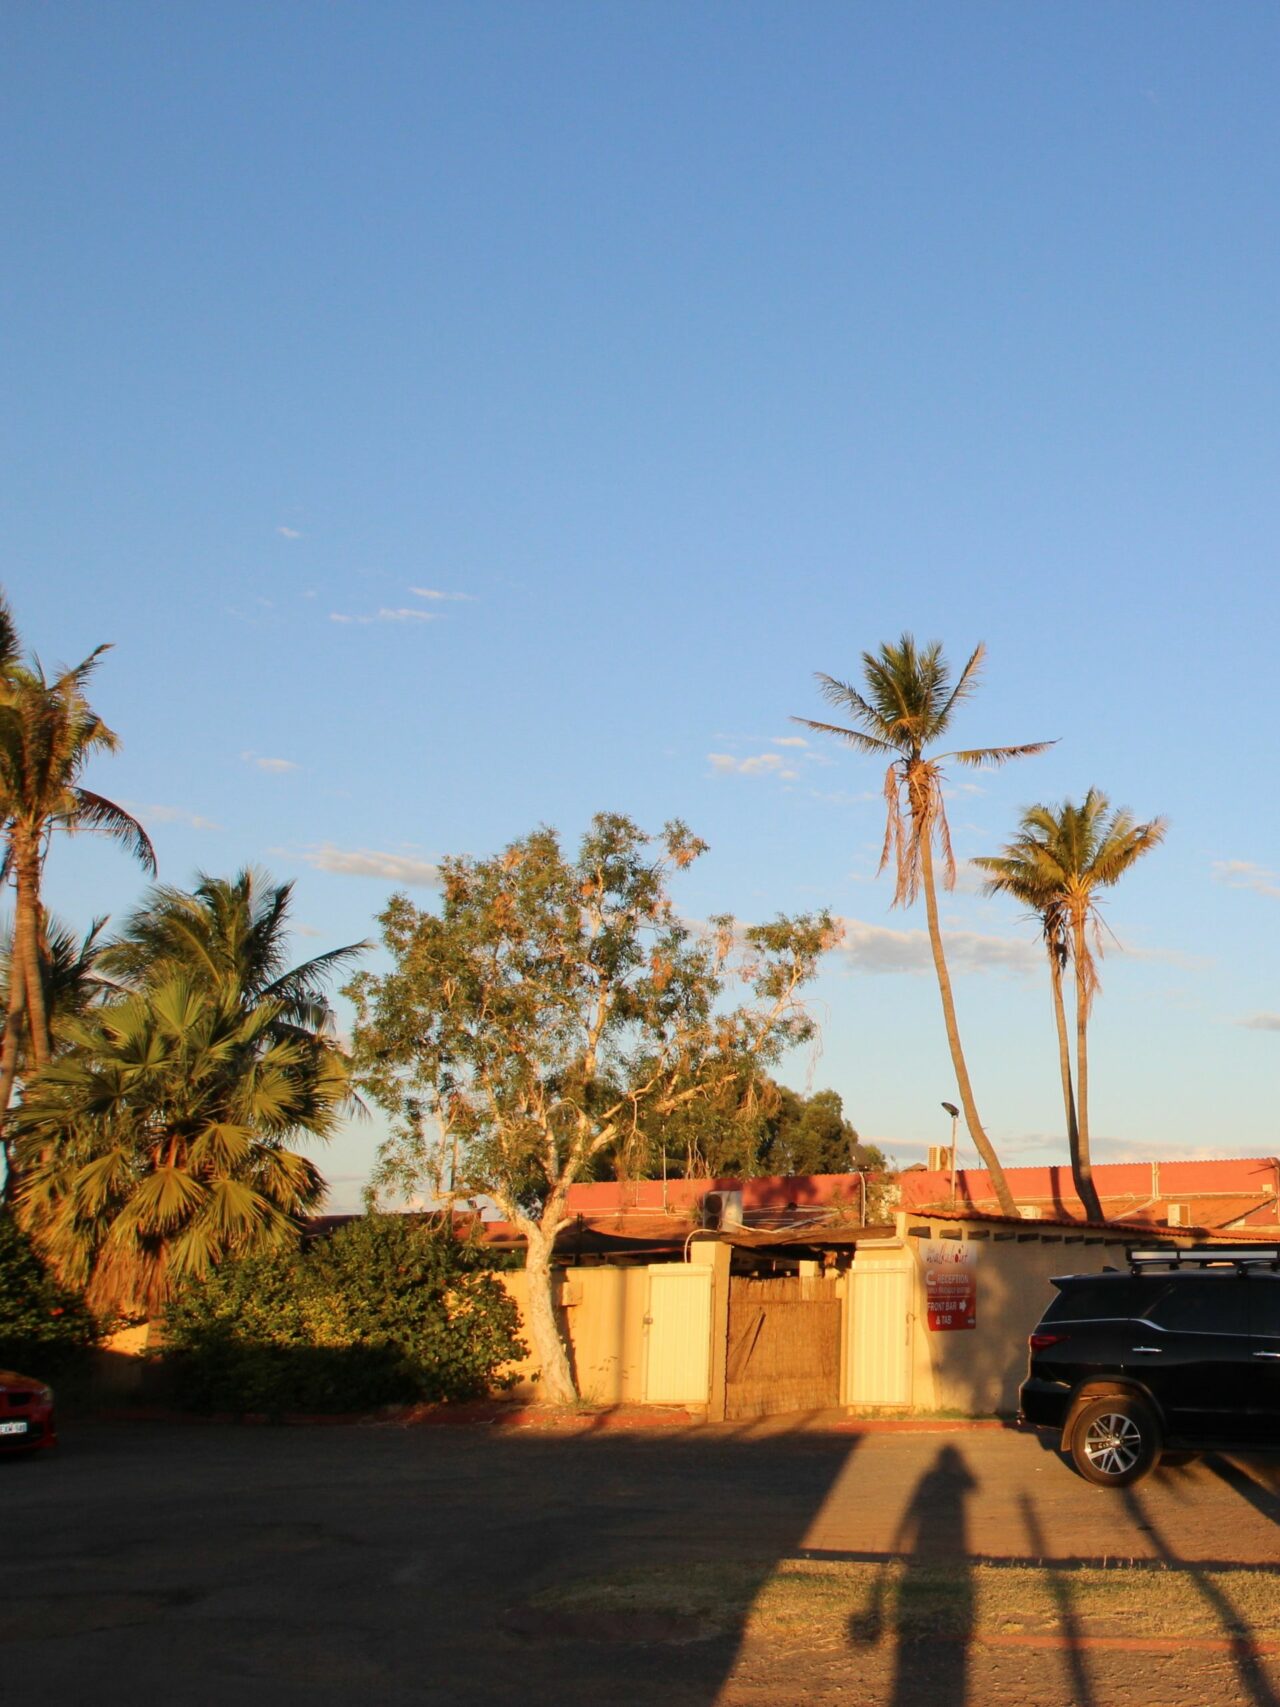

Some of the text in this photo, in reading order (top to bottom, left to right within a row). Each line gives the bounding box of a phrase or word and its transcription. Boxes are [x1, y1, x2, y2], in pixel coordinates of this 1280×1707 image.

[937, 1274, 969, 1284] RECEPTION
[928, 1301, 957, 1312] FRONT BAR
